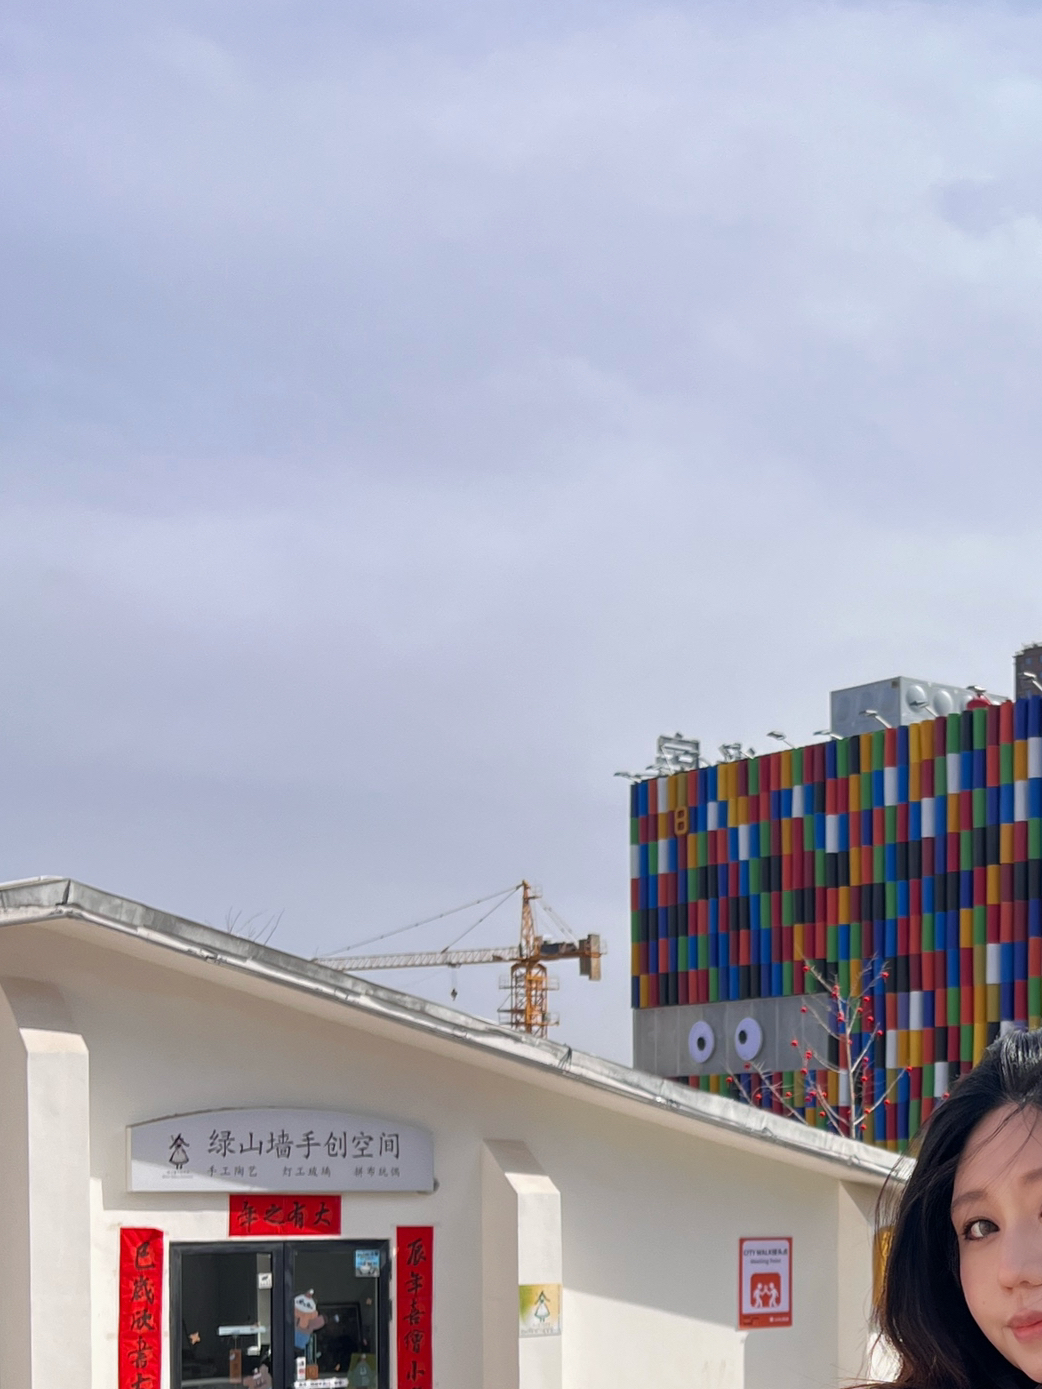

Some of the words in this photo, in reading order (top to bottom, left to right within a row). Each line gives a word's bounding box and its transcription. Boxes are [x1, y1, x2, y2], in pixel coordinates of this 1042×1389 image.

[207, 1129, 400, 1159] 绿山墙手创空间
